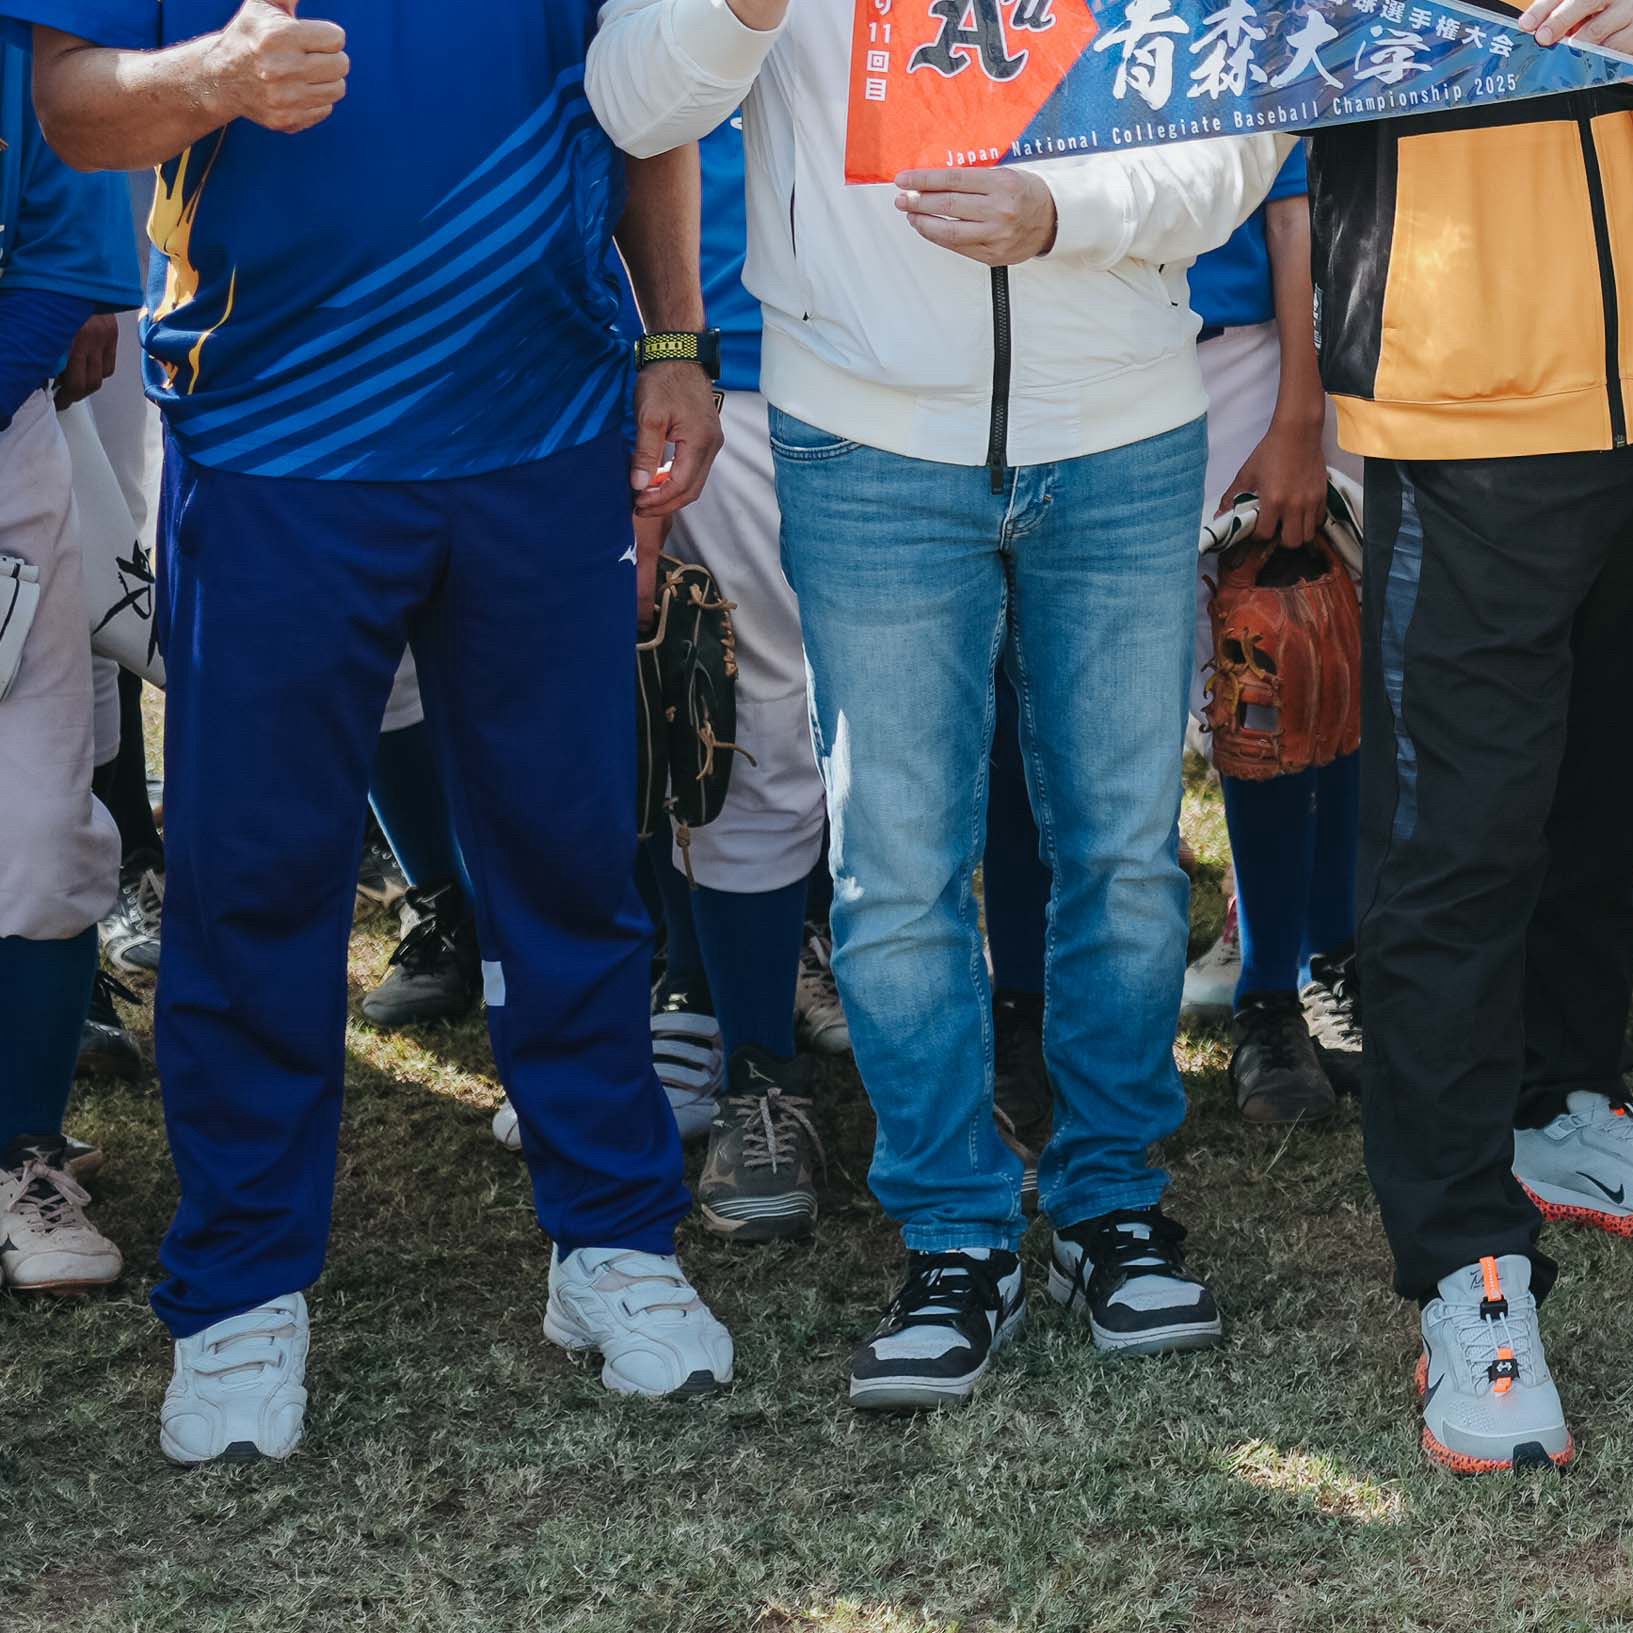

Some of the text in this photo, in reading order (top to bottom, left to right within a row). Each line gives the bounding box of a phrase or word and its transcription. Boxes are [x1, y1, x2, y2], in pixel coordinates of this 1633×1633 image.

[946, 74, 1517, 168] Japan National Collegiate Baseball Championship 2025
